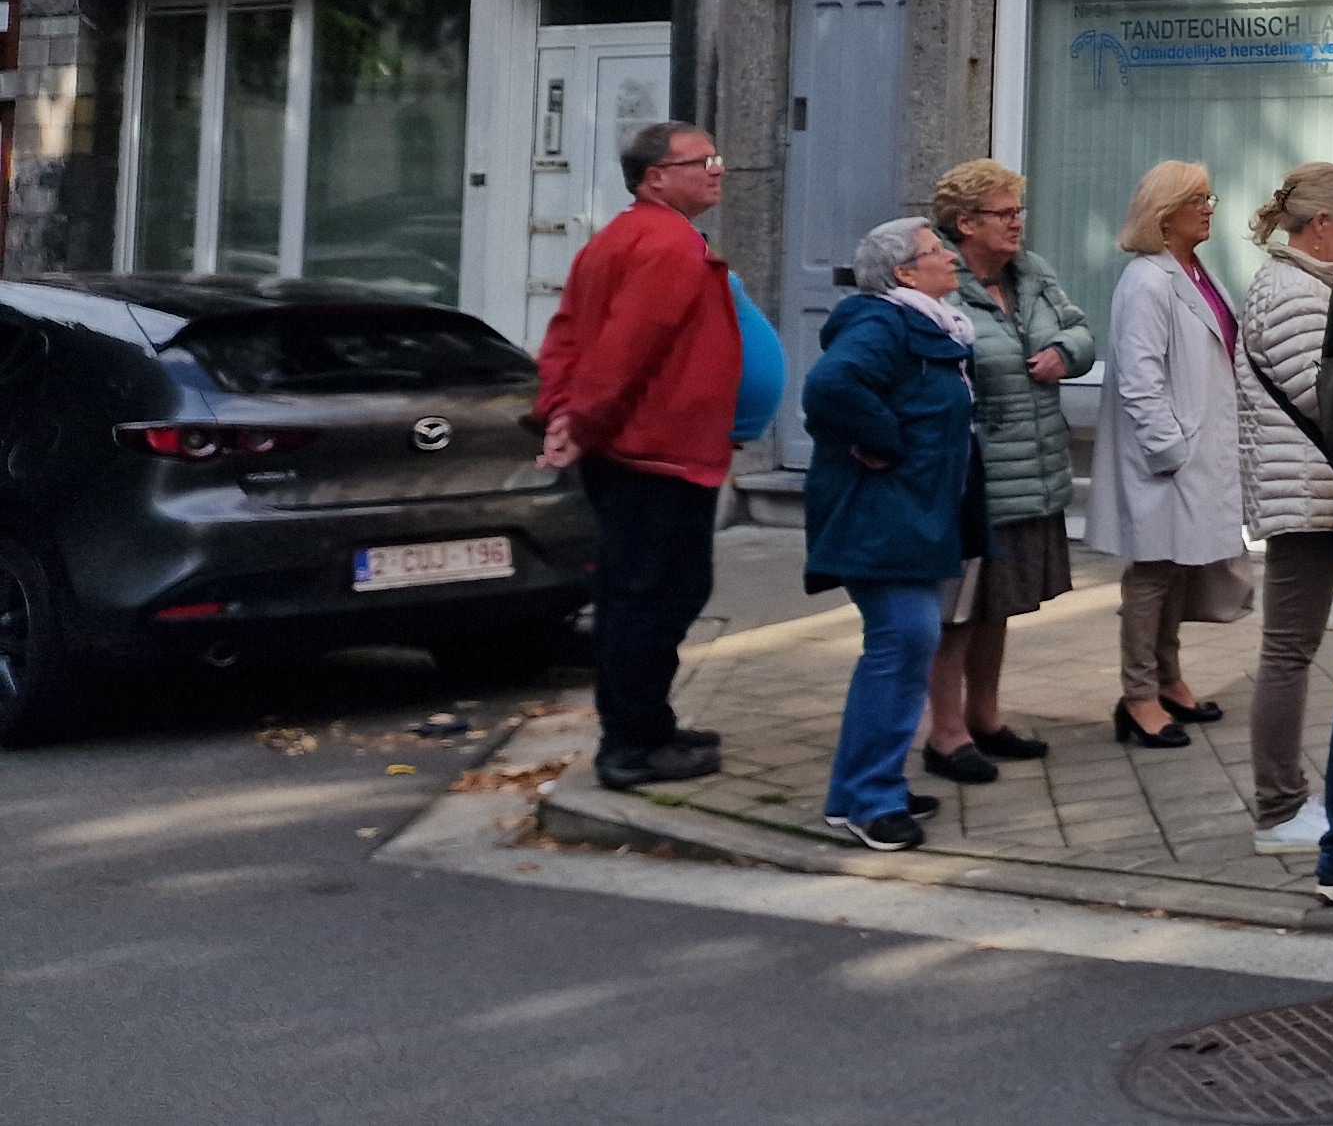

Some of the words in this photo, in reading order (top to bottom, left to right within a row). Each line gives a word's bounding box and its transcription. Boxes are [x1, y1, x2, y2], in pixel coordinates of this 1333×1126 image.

[1120, 15, 1299, 41] TANDTECHNISCH
[1130, 43, 1227, 61] Onmiddellijke
[1231, 40, 1314, 59] herstelling
